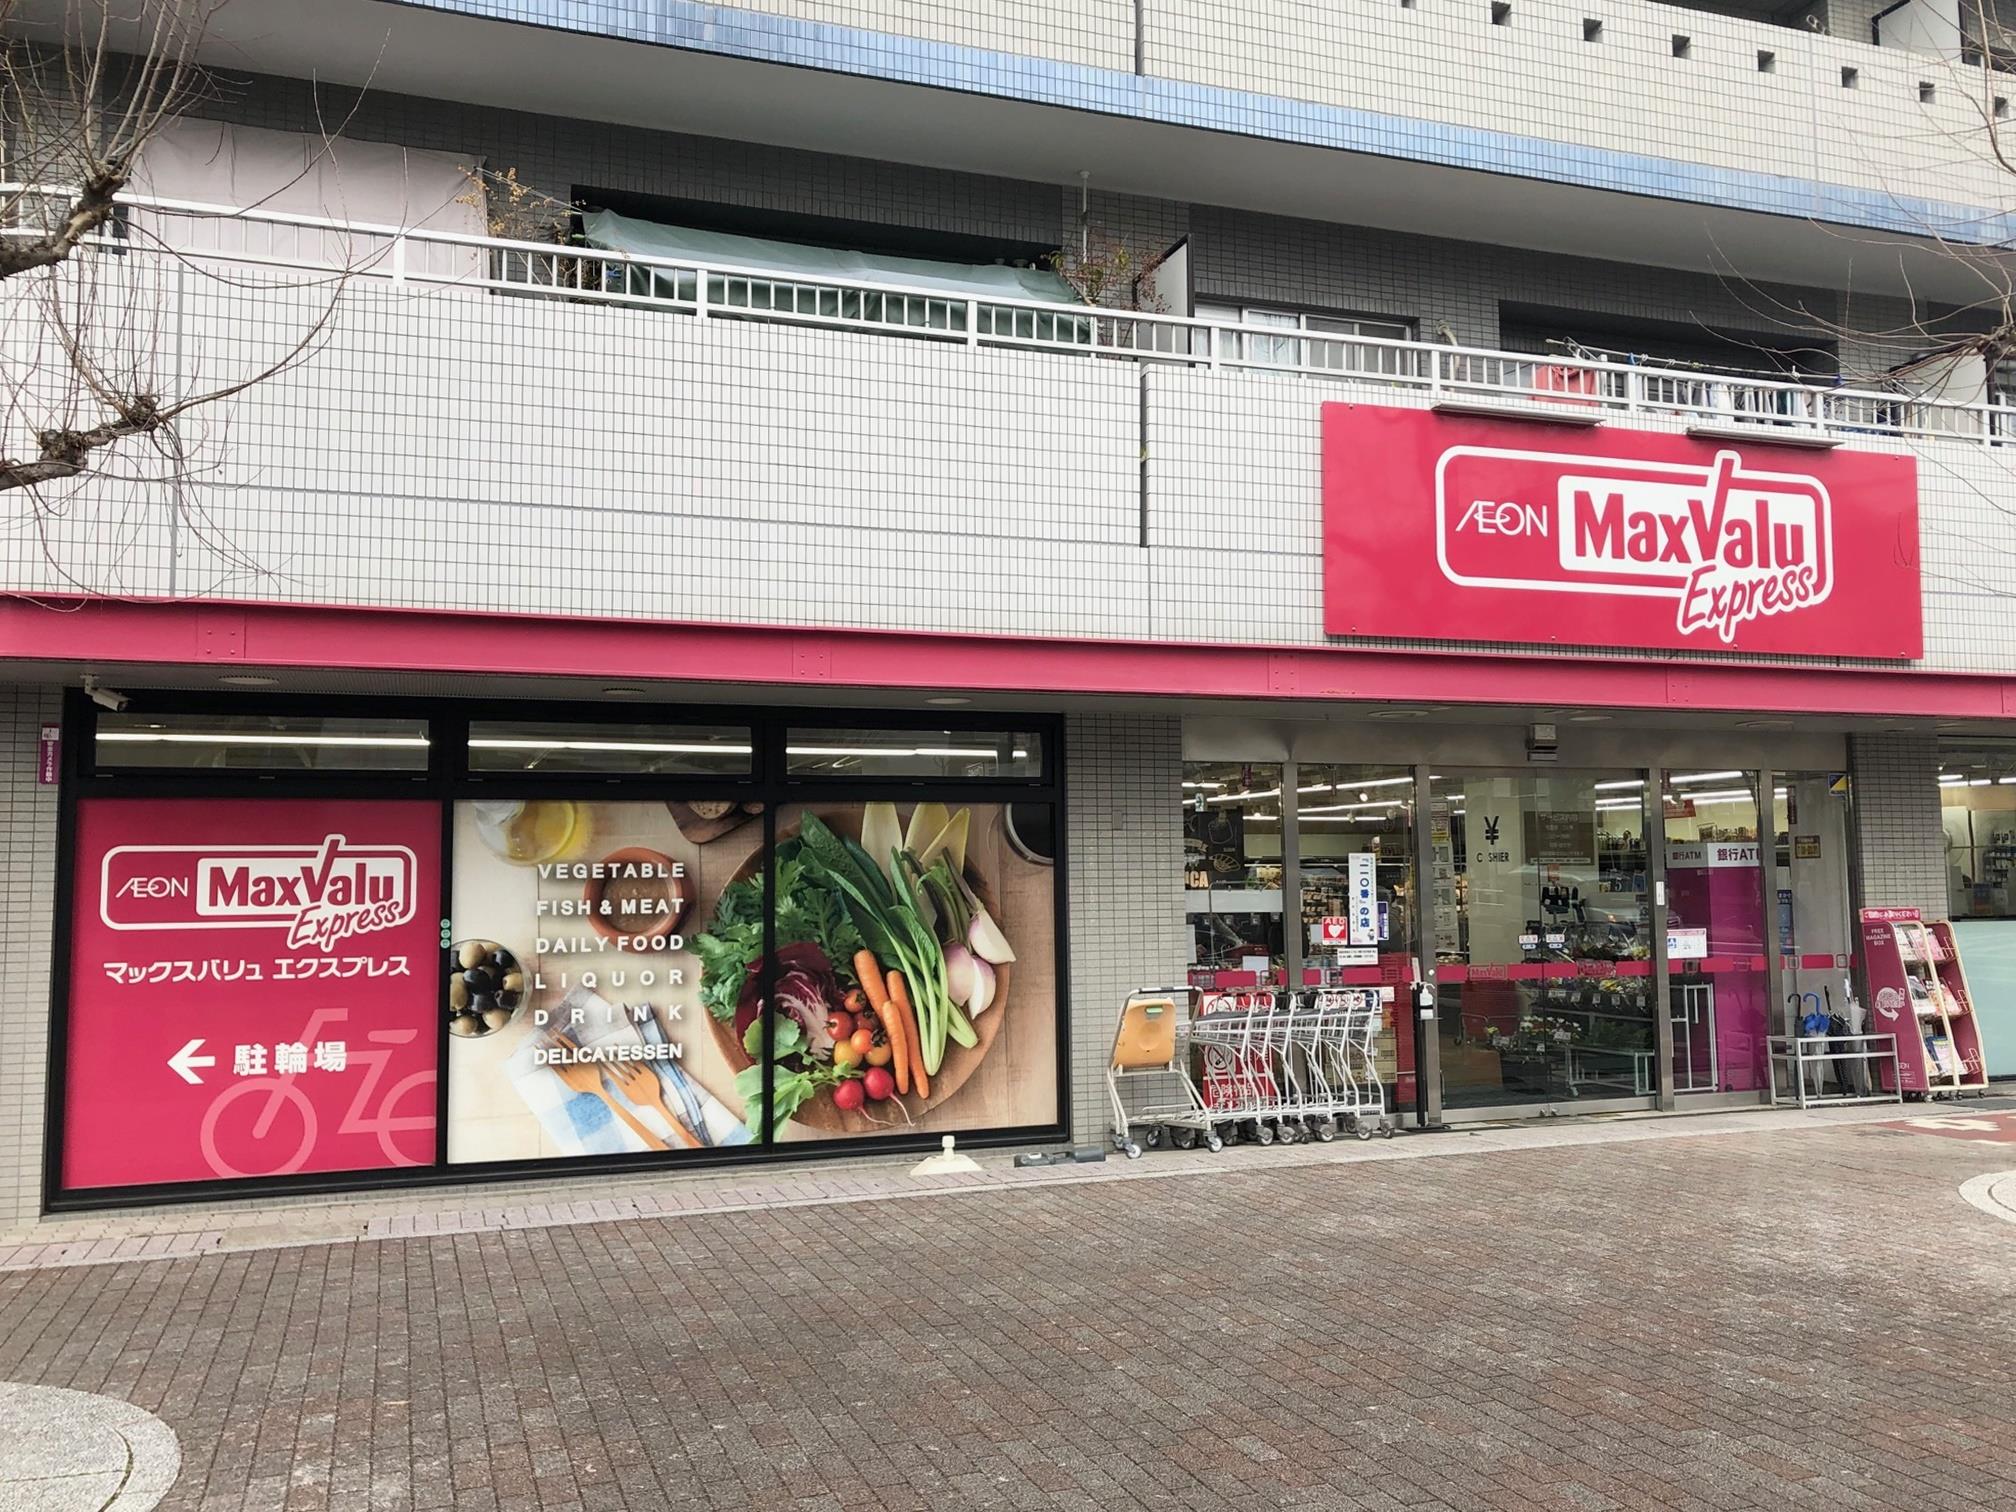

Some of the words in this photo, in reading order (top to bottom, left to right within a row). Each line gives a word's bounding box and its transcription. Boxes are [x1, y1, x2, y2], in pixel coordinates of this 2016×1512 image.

[1573, 458, 1804, 568] MaxValu
[1680, 563, 1815, 636] Express
[1476, 851, 1510, 863] CSHIER
[1672, 850, 1702, 861] 銀行ATM
[207, 839, 394, 908] MaxValu
[538, 862, 685, 879] VEGETABLE
[536, 900, 591, 916] FISH
[599, 899, 613, 915] &
[620, 898, 684, 915] MEAT
[290, 899, 401, 946] Express
[1324, 917, 1345, 925] AED
[536, 936, 608, 954] DAILY
[617, 934, 684, 951] FOOD
[103, 960, 264, 984] マックスバリュ
[272, 956, 411, 981] エクスプレス
[535, 969, 683, 989] LIQUOR
[534, 1004, 683, 1026] DRINK
[232, 1042, 348, 1076] 駐輪場
[533, 1042, 683, 1065] DELICATESSEN
